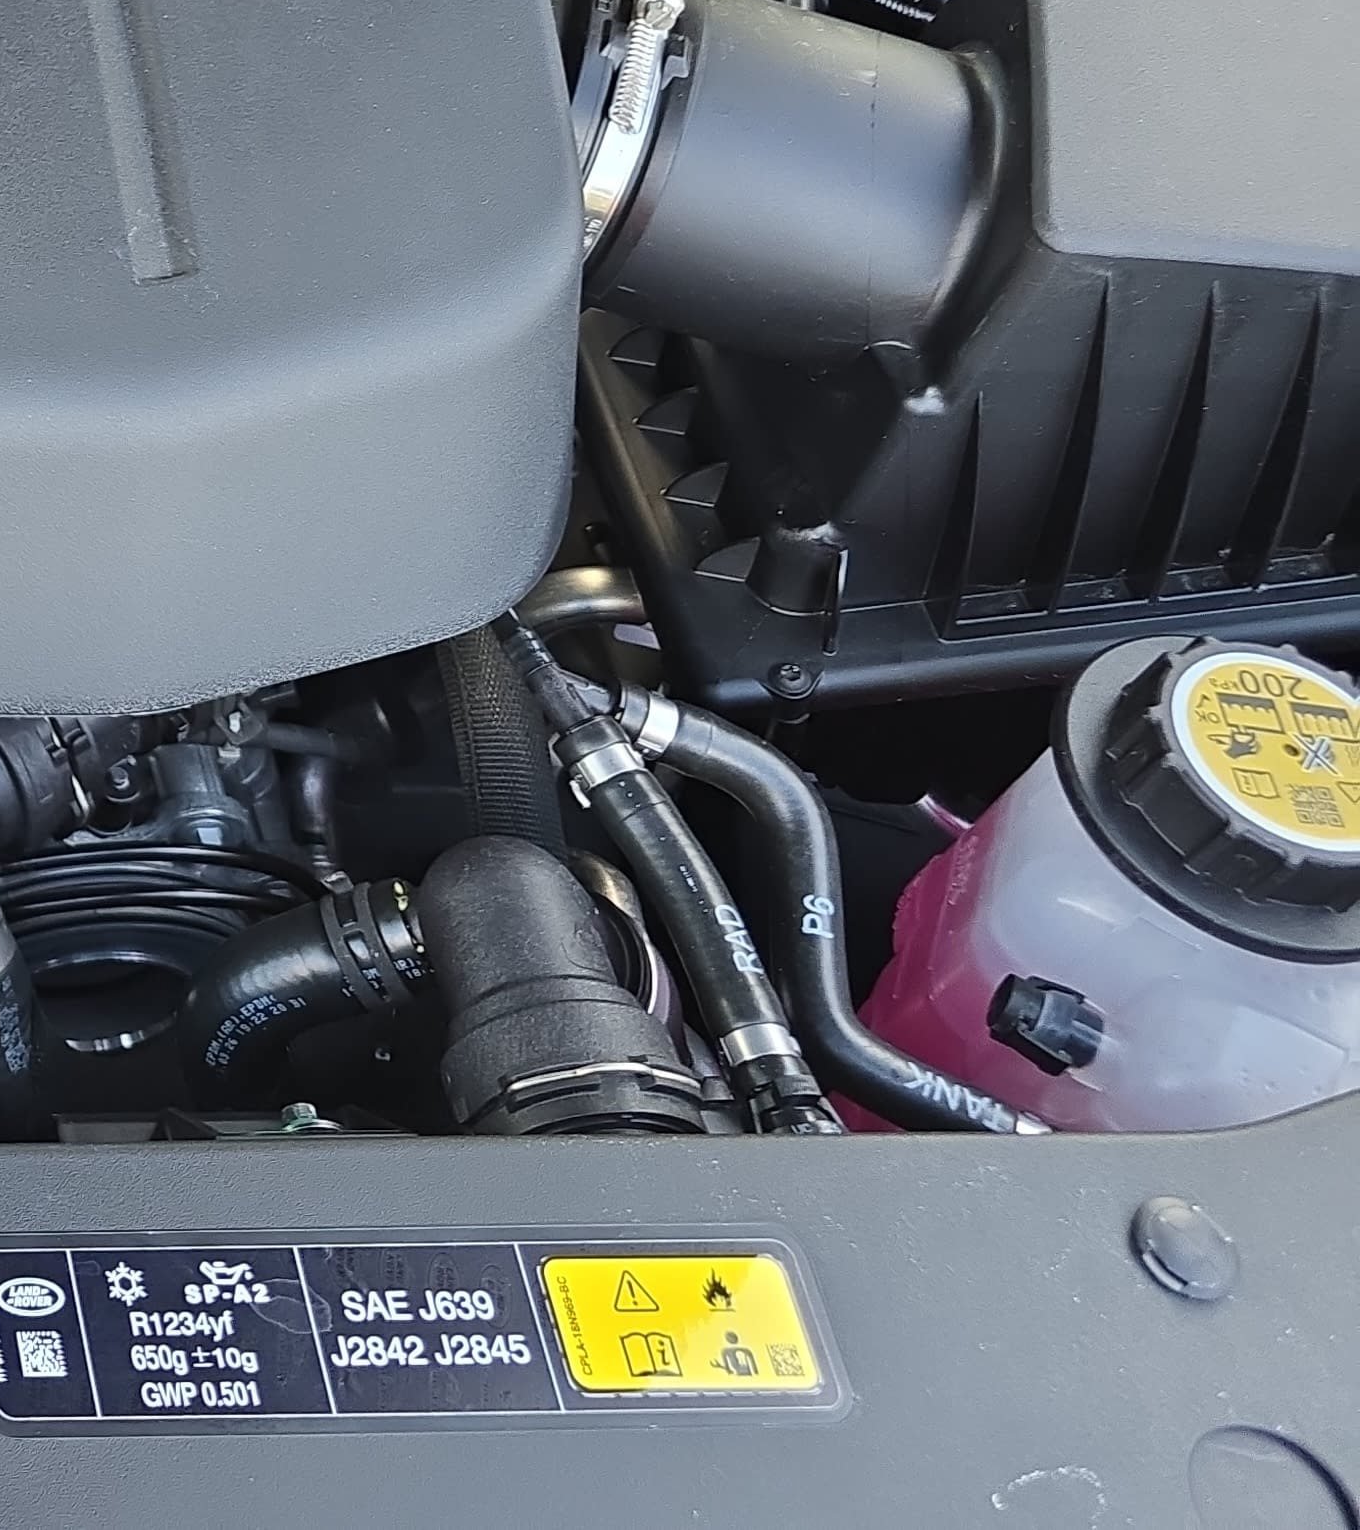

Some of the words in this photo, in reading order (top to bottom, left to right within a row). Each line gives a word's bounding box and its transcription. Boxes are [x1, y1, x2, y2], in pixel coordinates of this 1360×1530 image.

[1238, 669, 1310, 701] 200
[1195, 709, 1222, 725] OK
[801, 893, 834, 939] P6
[714, 903, 766, 975] RAD
[905, 1063, 1008, 1134] TANK
[8, 1286, 42, 1297] LAND
[12, 1296, 54, 1308] ROVER
[183, 1283, 271, 1304] SP-A2
[341, 1290, 414, 1321] SAE
[418, 1289, 496, 1321] J639
[129, 1310, 235, 1341] R1234yf
[131, 1344, 189, 1376] 650g
[190, 1345, 260, 1375] ±10g
[331, 1335, 430, 1367] J2842
[433, 1333, 531, 1366] J2845
[140, 1381, 197, 1408] GWP
[200, 1380, 262, 1407] 0.501
